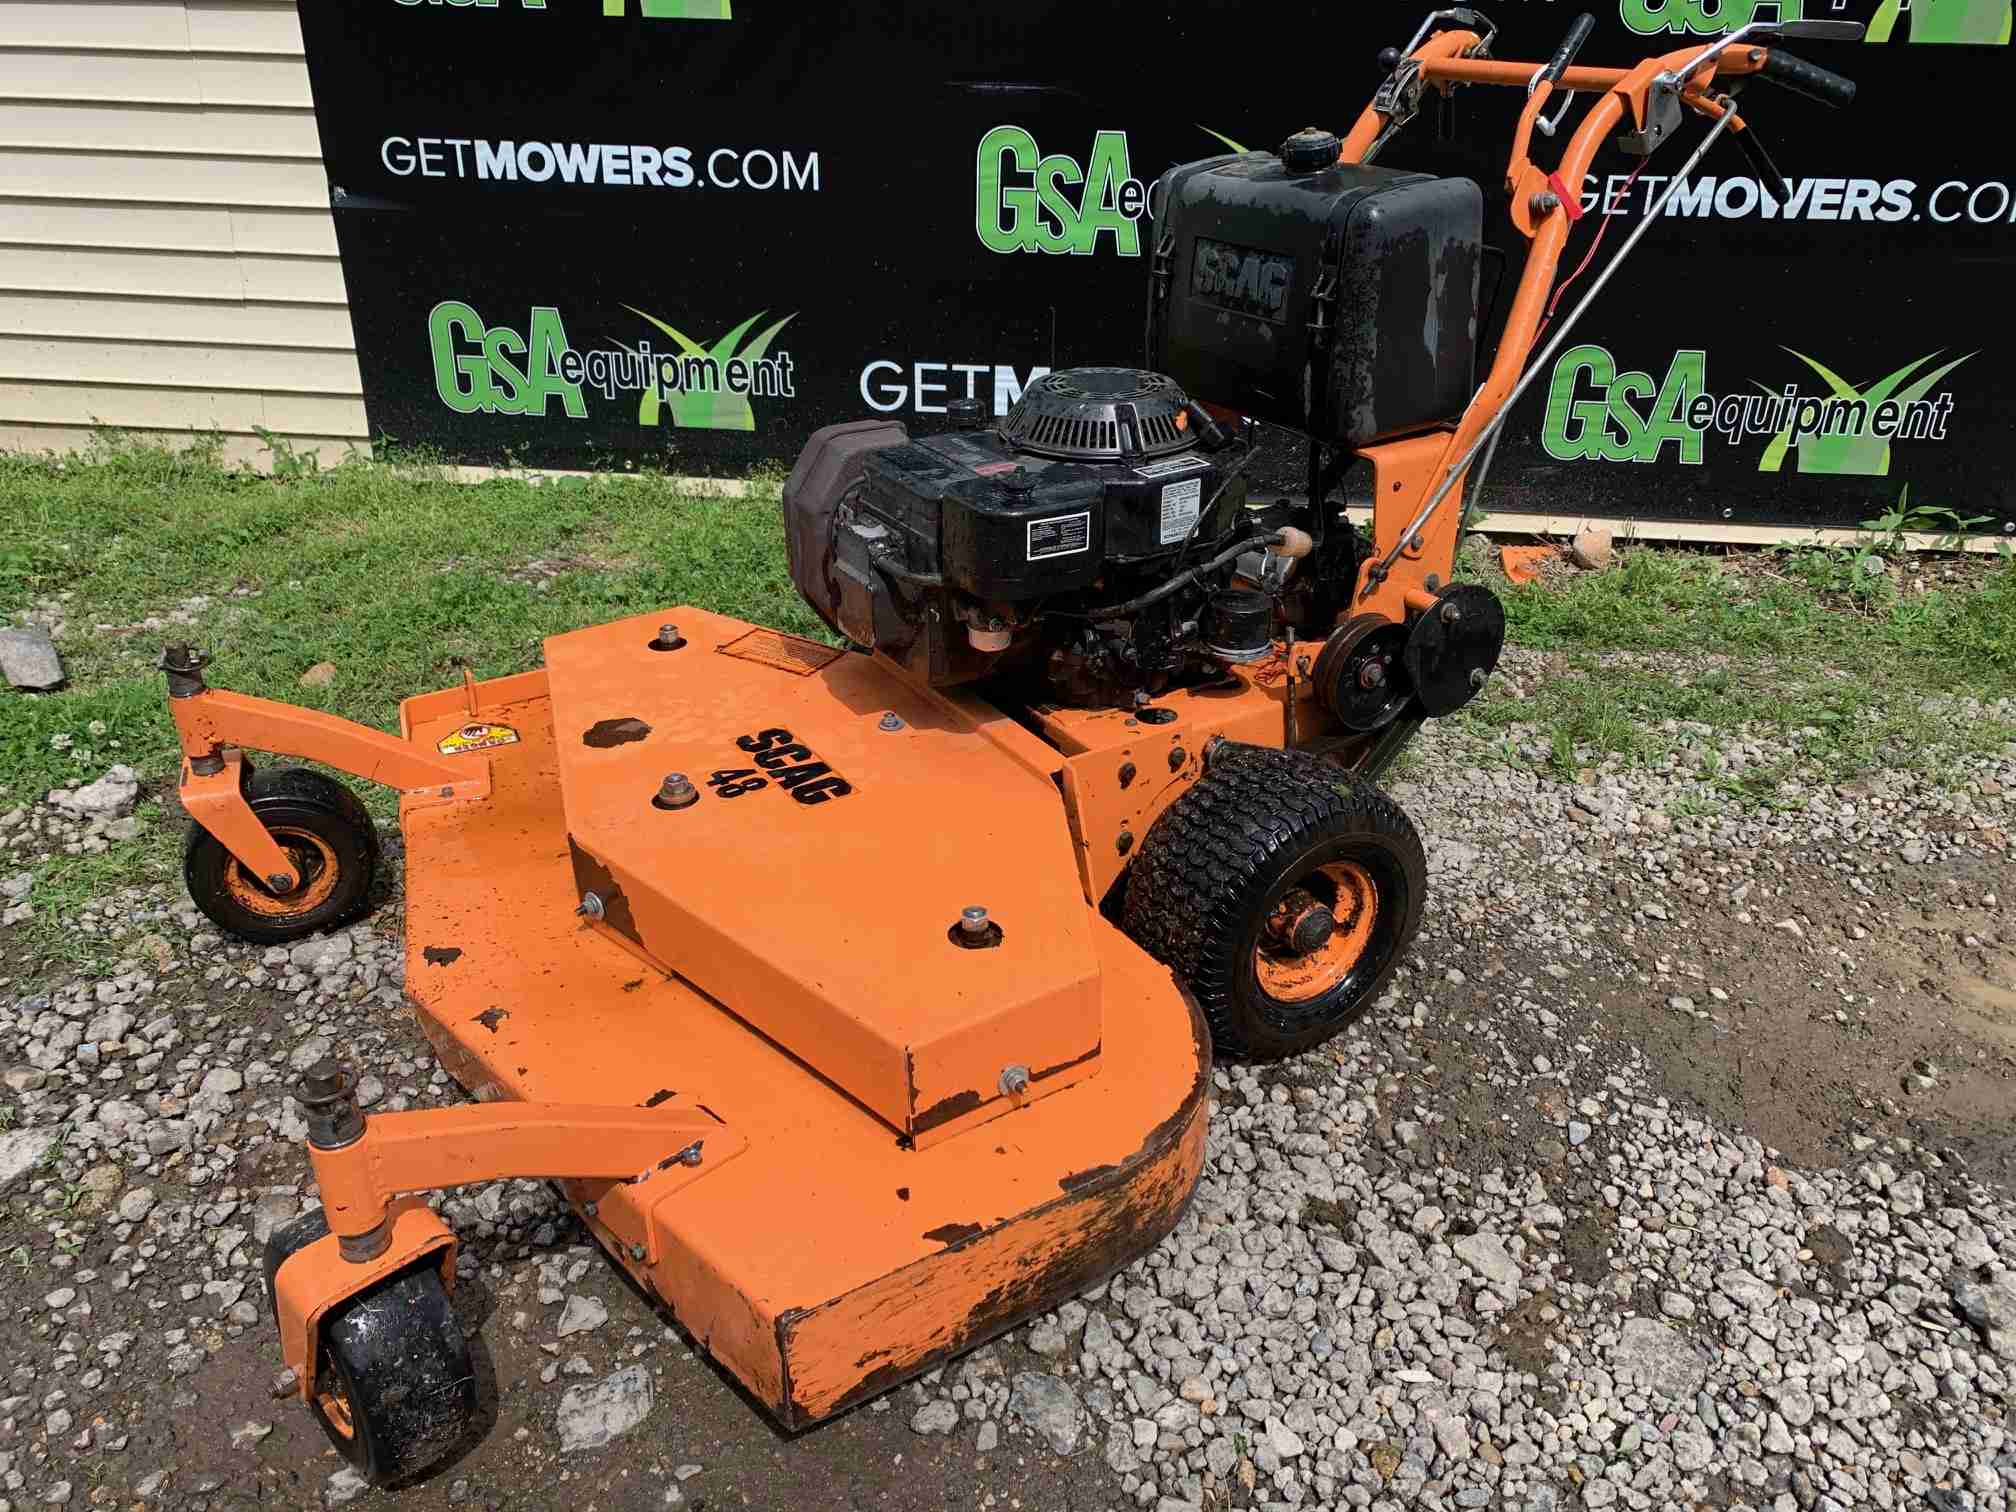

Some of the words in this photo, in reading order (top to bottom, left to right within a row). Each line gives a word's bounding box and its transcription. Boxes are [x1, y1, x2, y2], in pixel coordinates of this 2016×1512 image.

[380, 136, 820, 192] GETMOWERS.COM
[1578, 175, 2016, 223] GETMOWERS.CO
[706, 769, 769, 798] 48
[735, 728, 853, 805] SCAG
